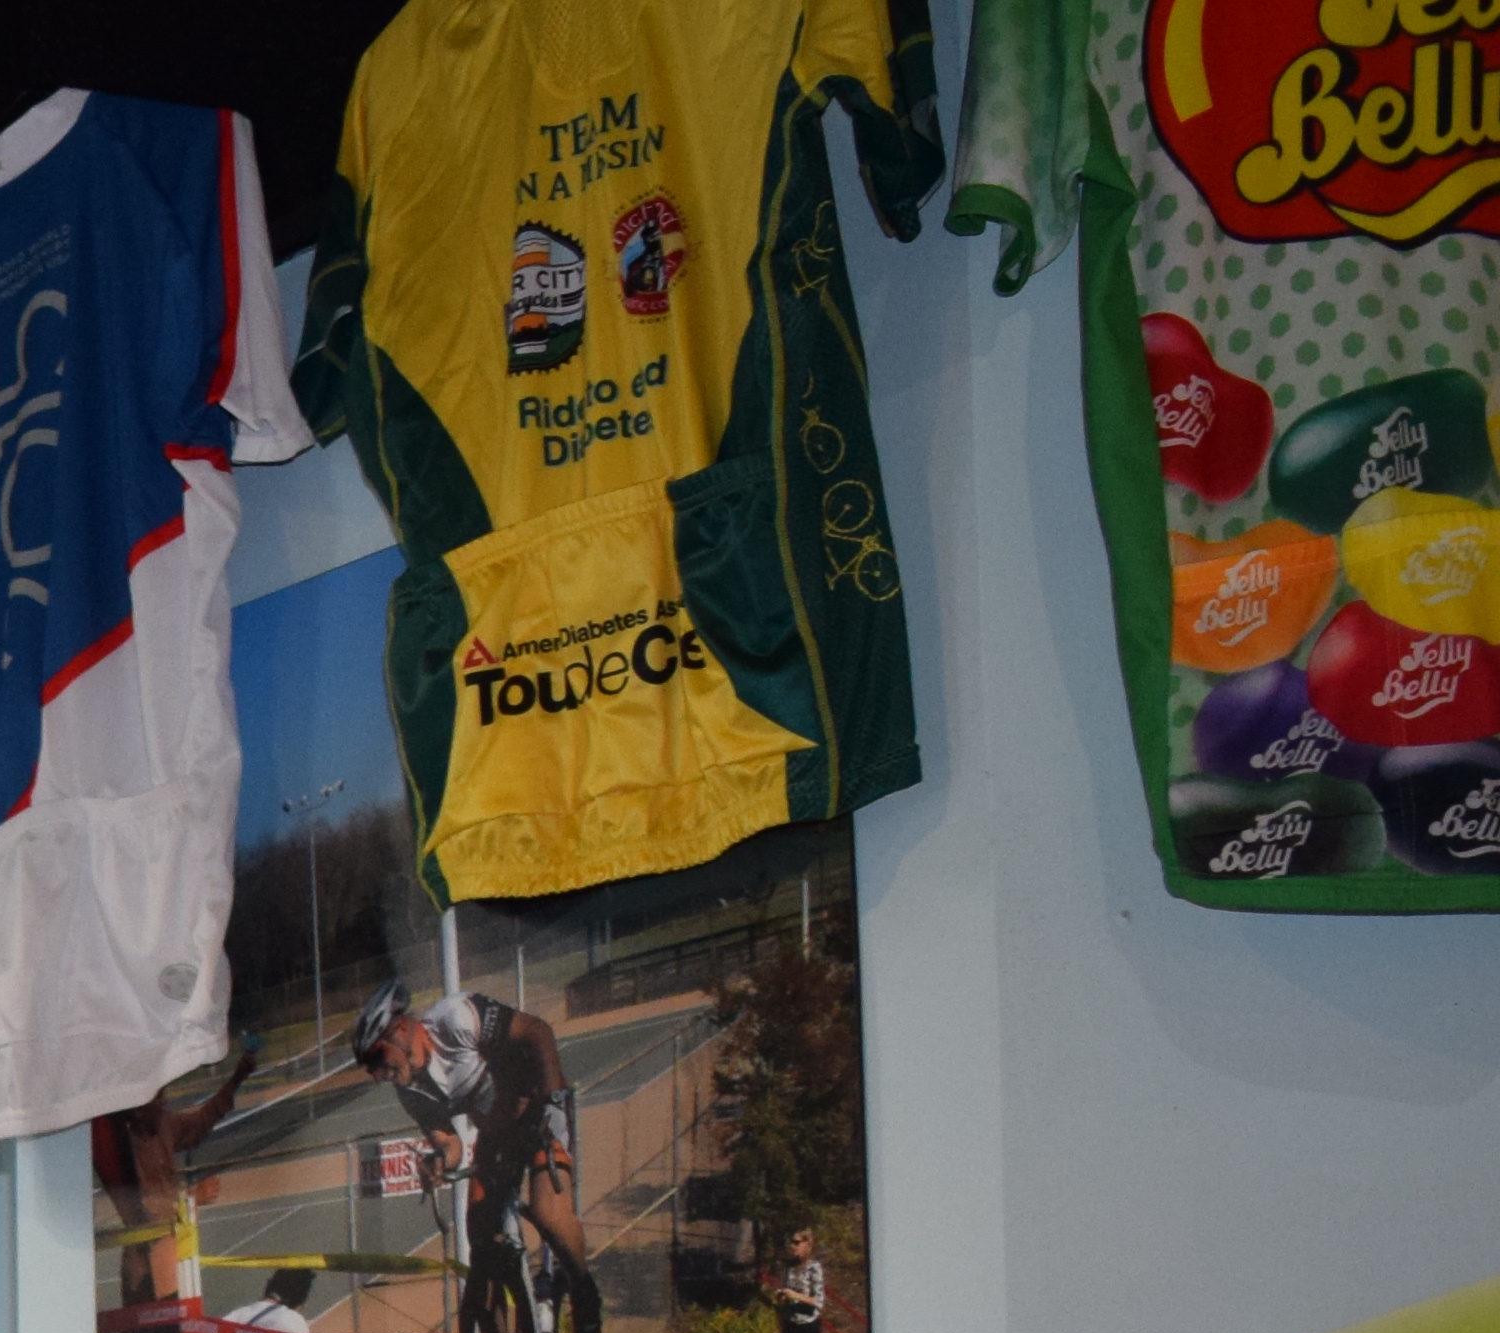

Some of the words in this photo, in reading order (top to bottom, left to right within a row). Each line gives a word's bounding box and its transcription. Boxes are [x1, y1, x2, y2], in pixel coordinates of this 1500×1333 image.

[1370, 406, 1428, 458] Jelly
[1354, 453, 1423, 501] Belly
[1219, 549, 1281, 599] Jelly
[1194, 597, 1269, 641] Belly
[1401, 633, 1473, 671] Jelly
[1373, 667, 1460, 708] Belly
[1250, 736, 1330, 774] Belly
[1241, 800, 1313, 842] Jelly
[1210, 835, 1295, 876] Belly
